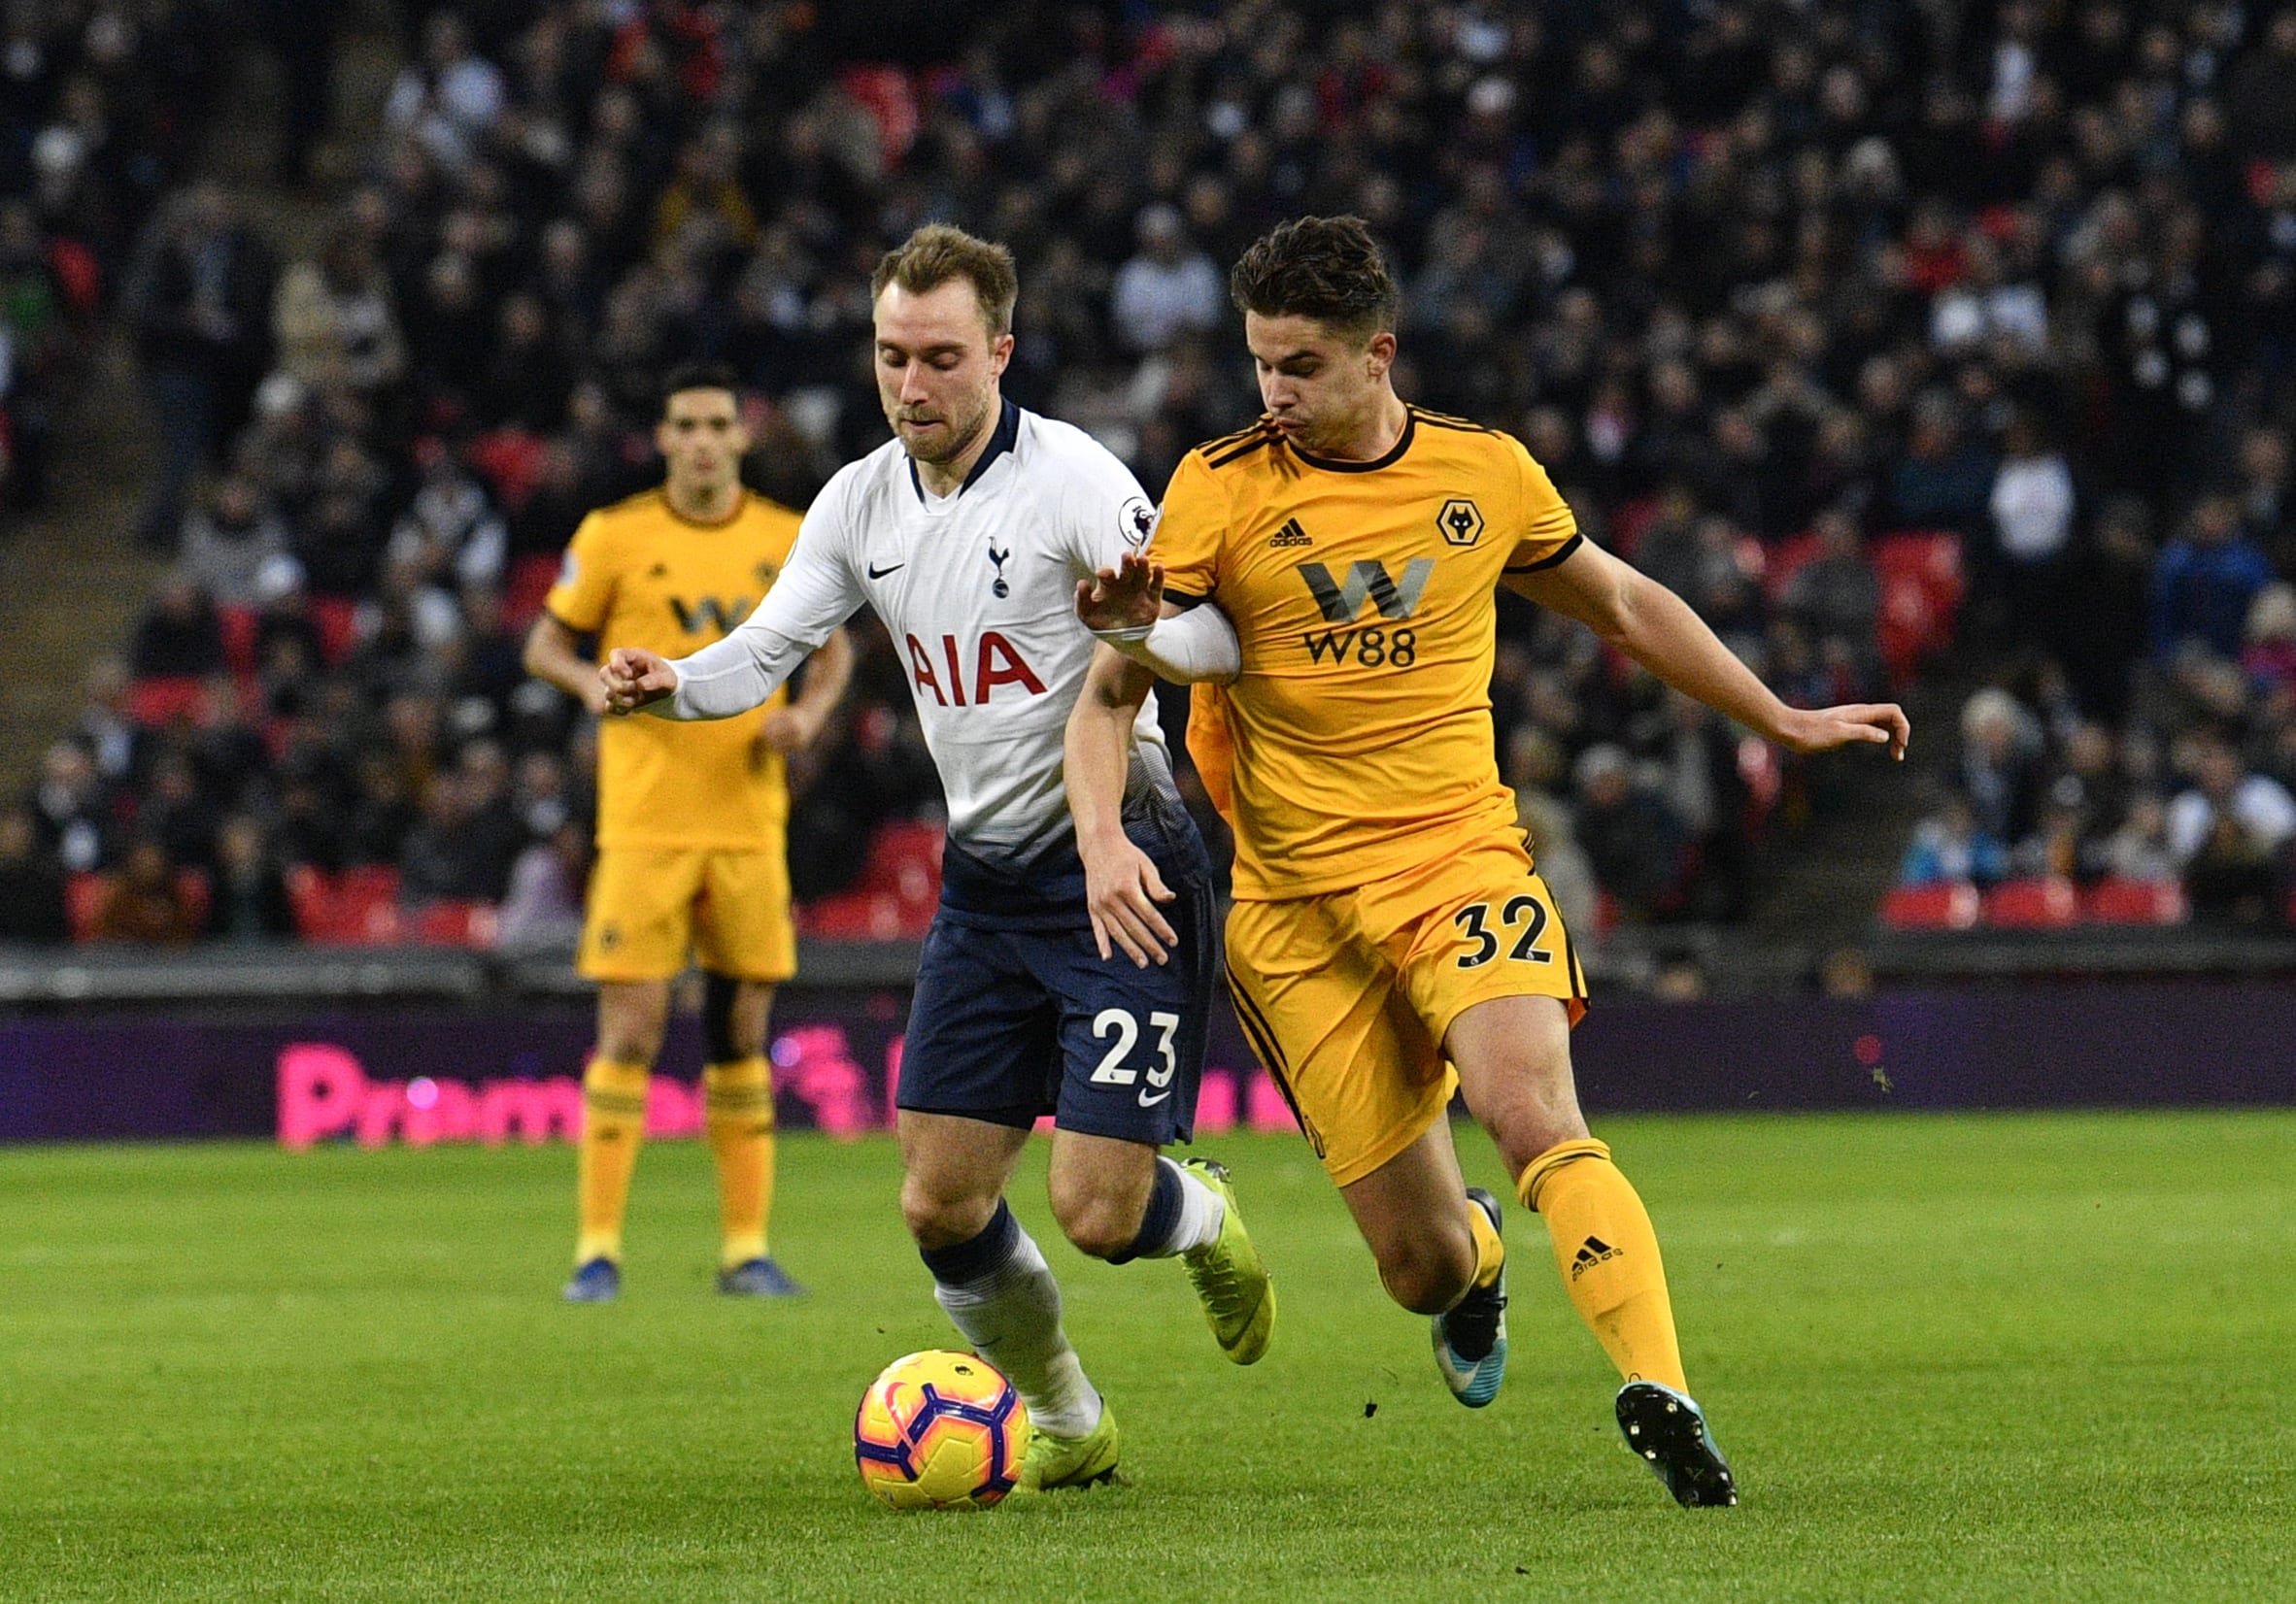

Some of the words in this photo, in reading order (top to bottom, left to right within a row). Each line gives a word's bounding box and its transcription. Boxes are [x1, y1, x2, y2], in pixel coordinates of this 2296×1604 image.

[906, 631, 1048, 707] AIA
[1304, 628, 1415, 667] W88
[1454, 894, 1552, 969] 32
[1090, 1008, 1179, 1087] 23
[1571, 1248, 1624, 1283] adidas
